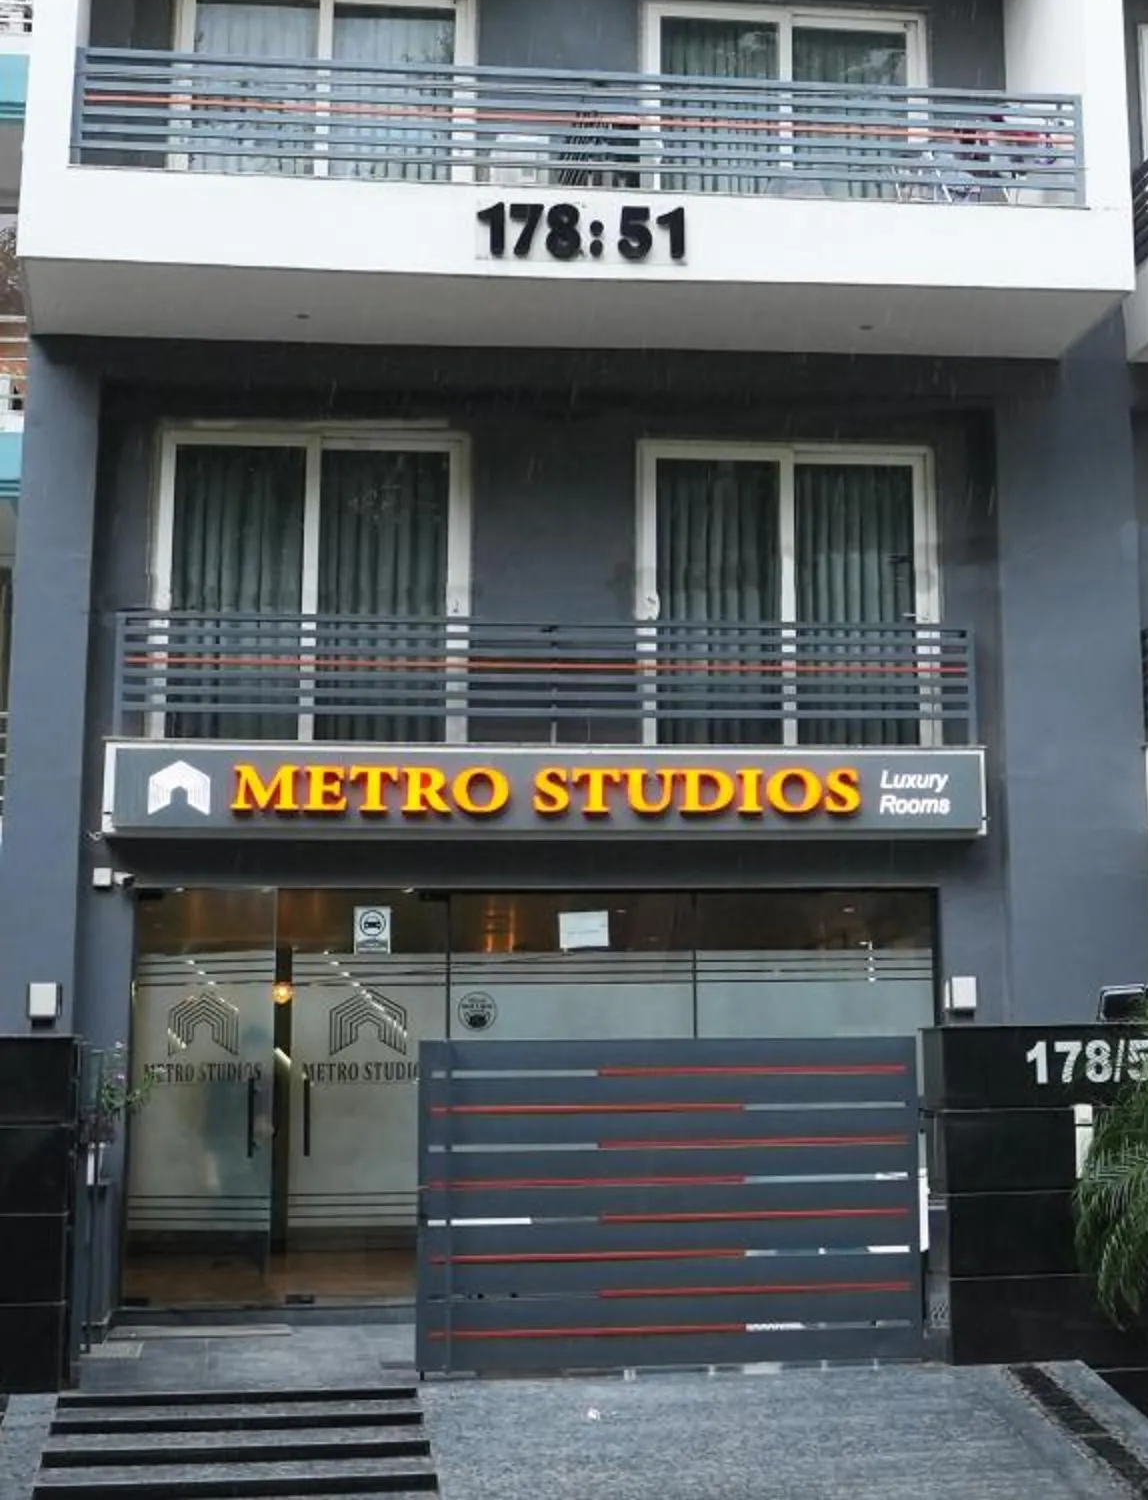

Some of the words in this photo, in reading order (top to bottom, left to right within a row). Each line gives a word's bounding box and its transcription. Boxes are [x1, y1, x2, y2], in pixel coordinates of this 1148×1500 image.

[231, 764, 511, 815] METRO
[533, 767, 861, 816] STUDIOS
[880, 770, 949, 792] Luxury
[879, 796, 950, 815] Rooms
[143, 1062, 194, 1082] METRO
[200, 1062, 263, 1082] STUDIOS
[304, 1061, 359, 1082] METRO
